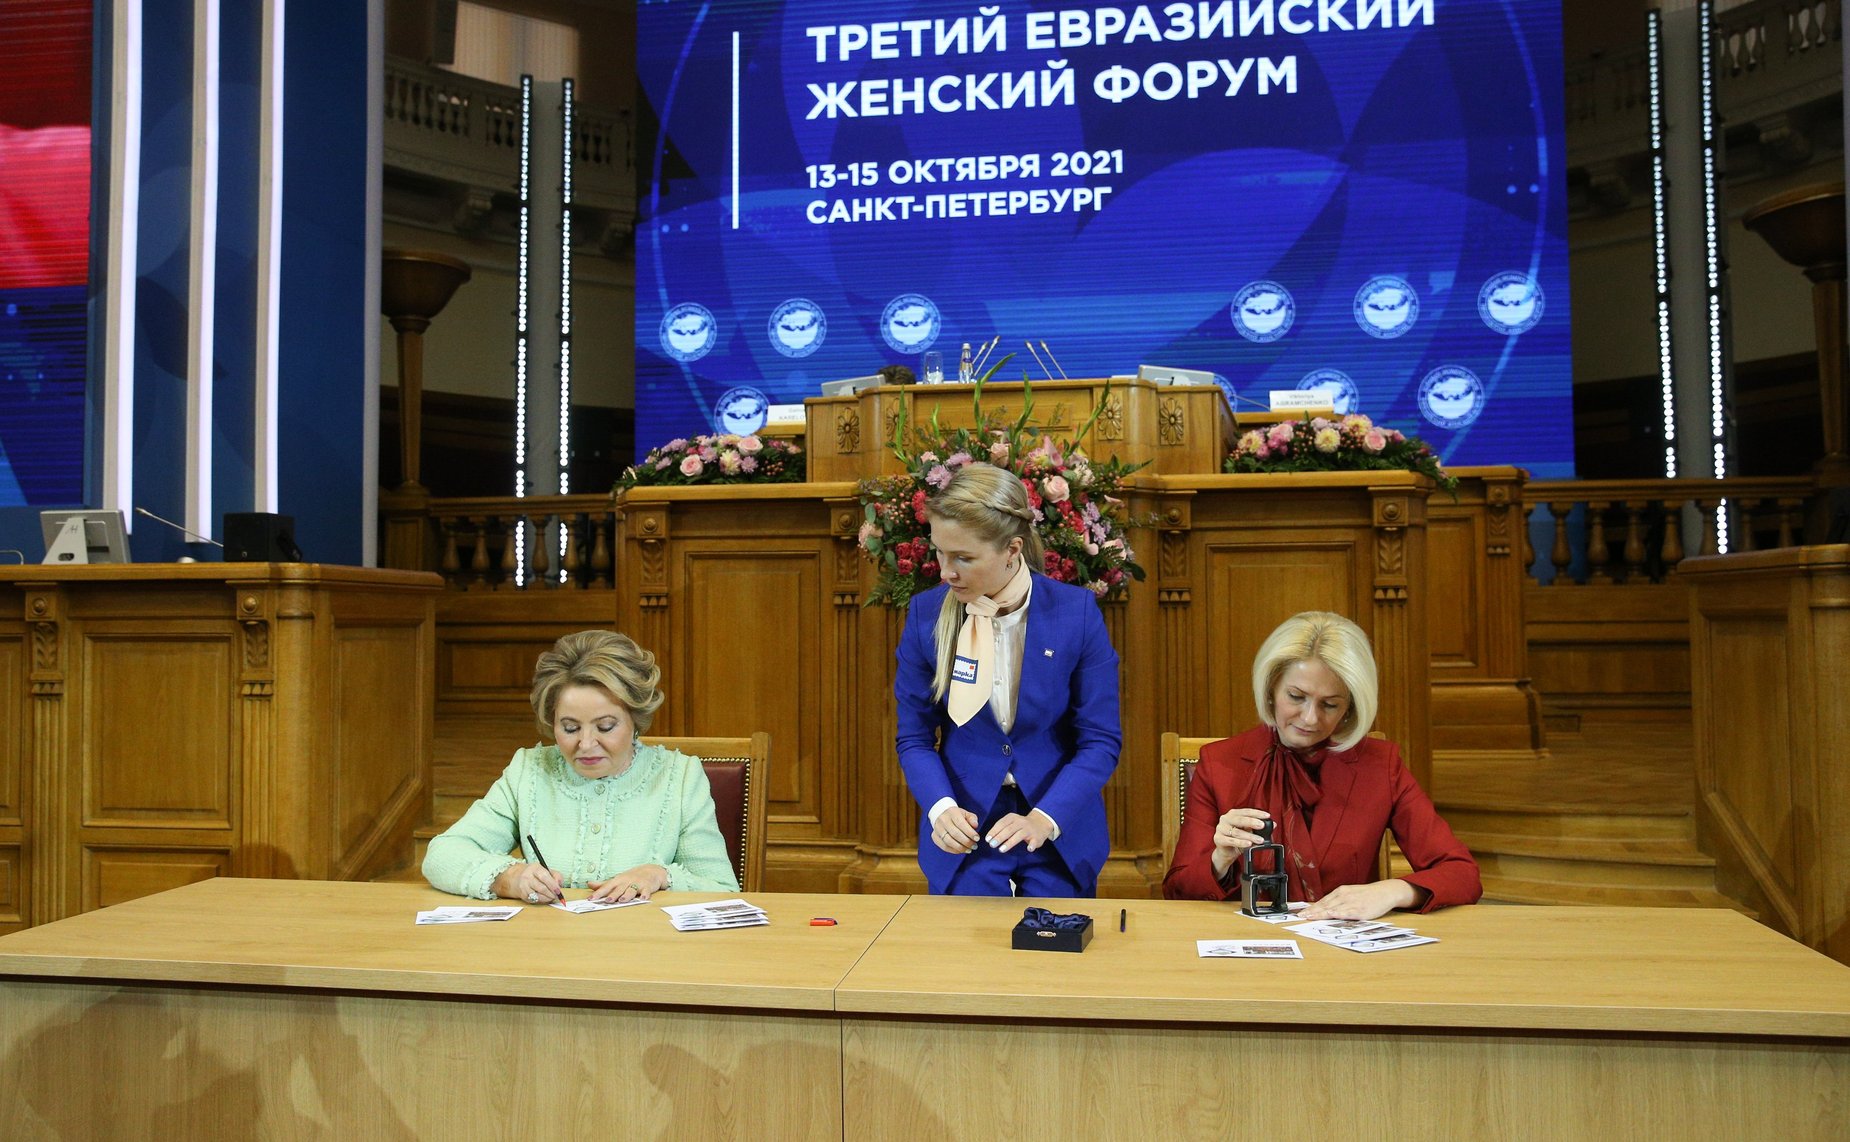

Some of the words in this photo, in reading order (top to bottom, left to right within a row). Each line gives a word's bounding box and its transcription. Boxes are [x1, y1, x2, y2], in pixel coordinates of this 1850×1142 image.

[806, 6, 1007, 62] ТРЕТИЙ
[805, 60, 1075, 119] ЖЕНСКИЙ
[1093, 56, 1298, 102] ФОРУМ
[805, 162, 879, 188] 13-15
[888, 154, 1040, 184] ОКТЯБРЯ
[1050, 150, 1123, 177] 2021
[806, 187, 1112, 224] САНКТ-ПЕТЕРБУРГ
